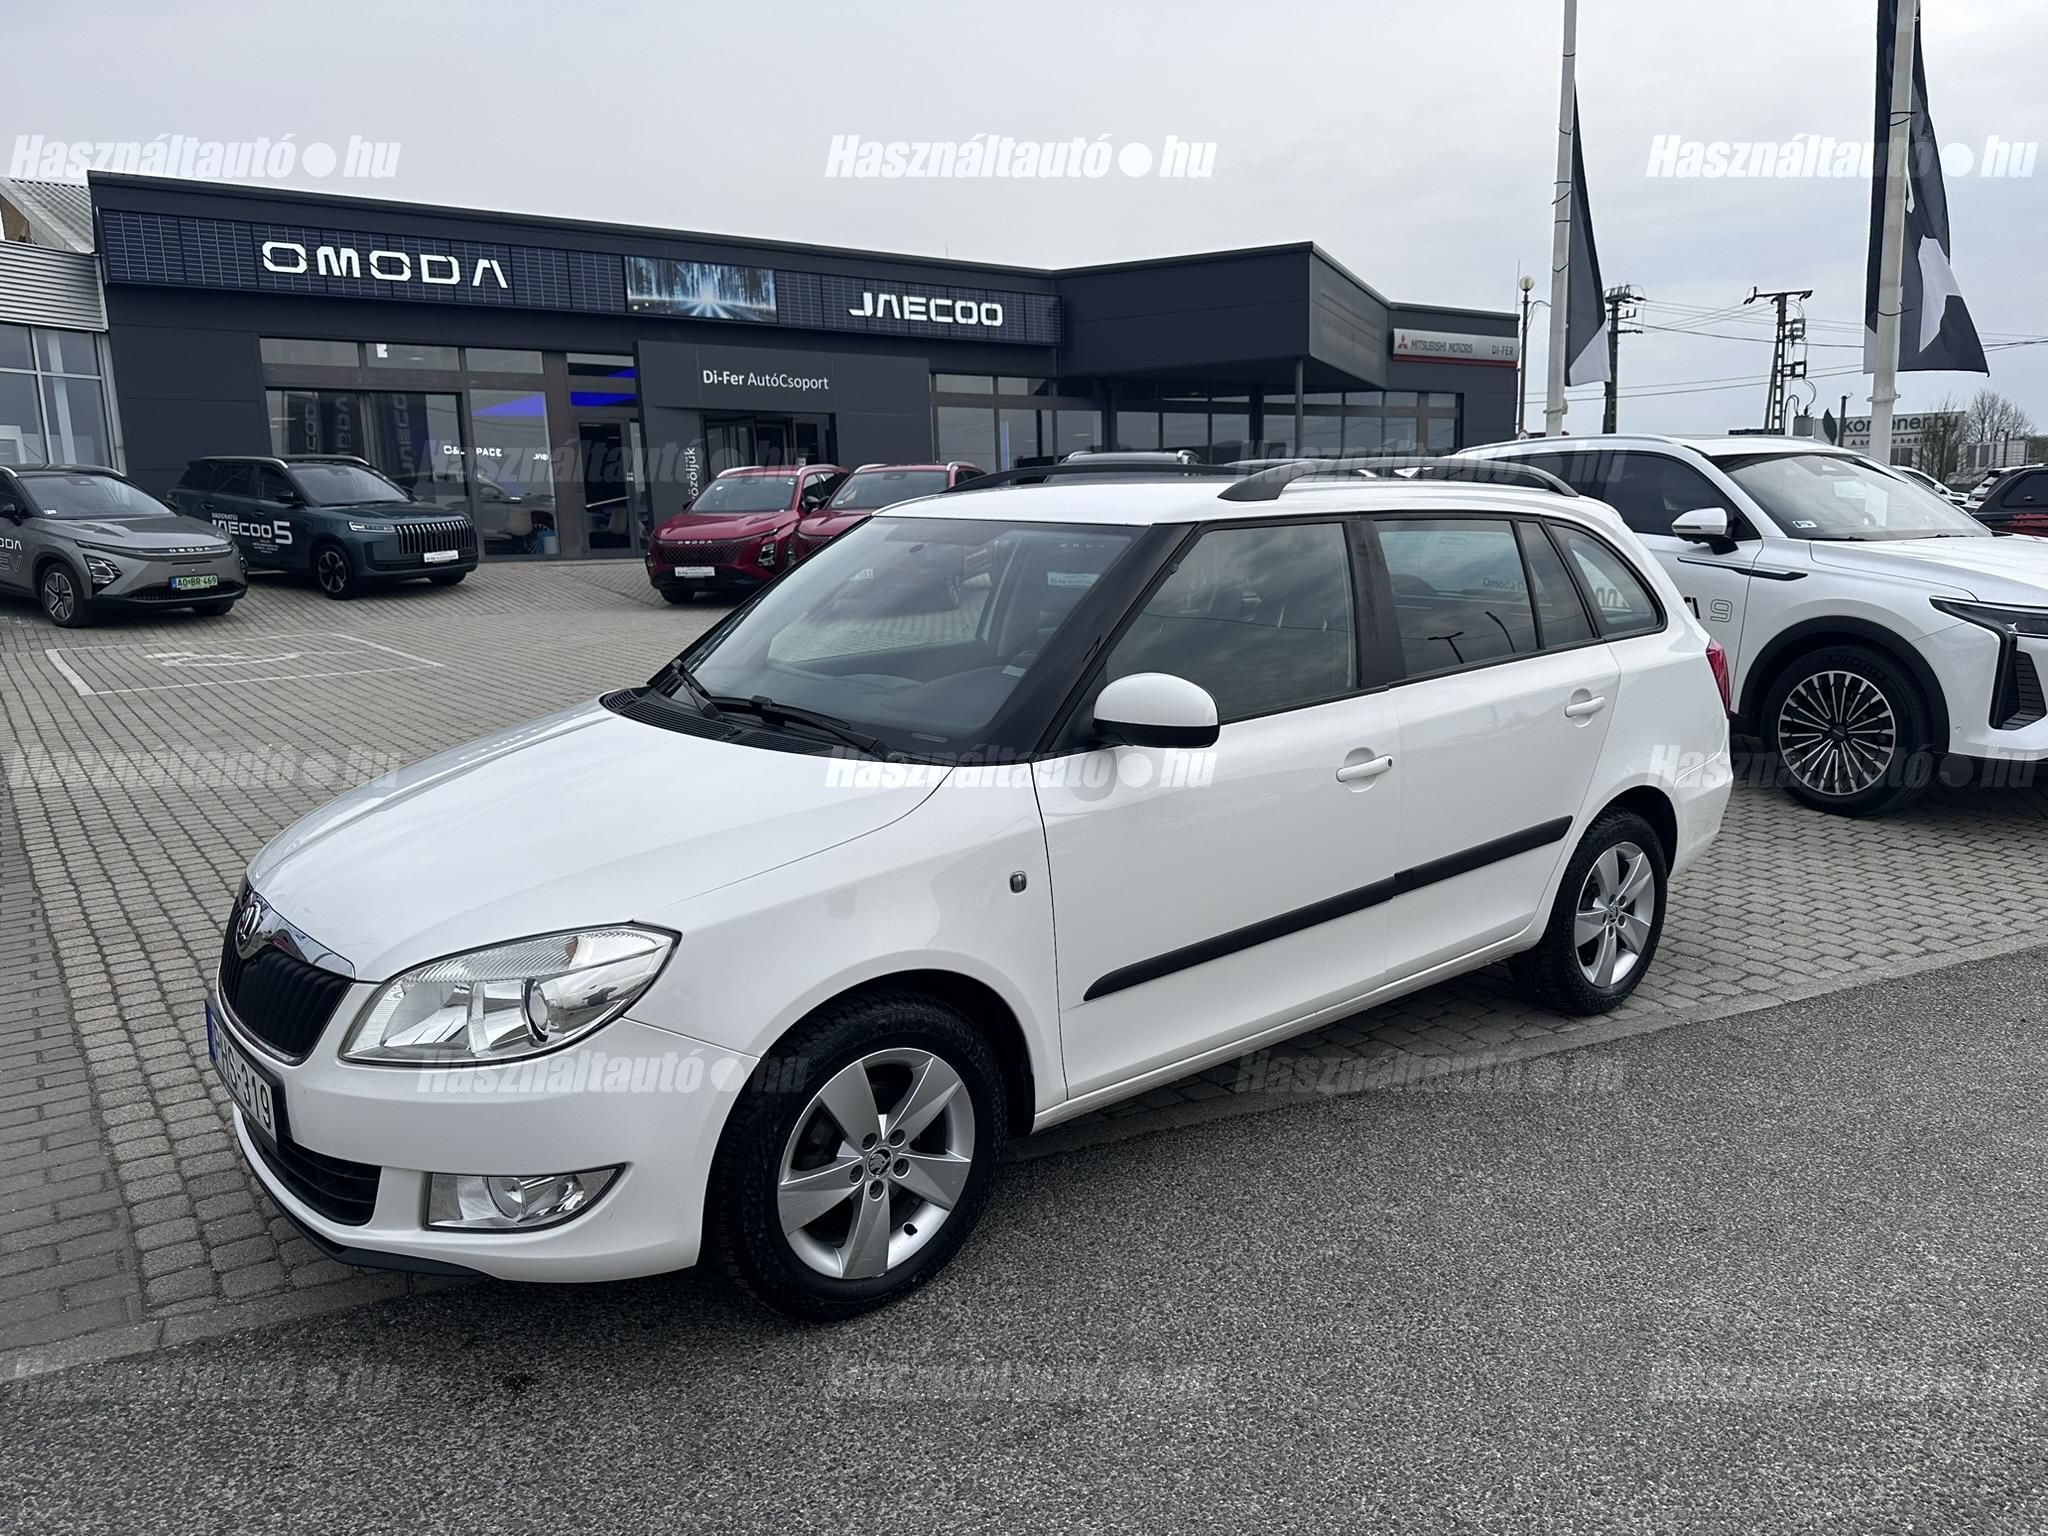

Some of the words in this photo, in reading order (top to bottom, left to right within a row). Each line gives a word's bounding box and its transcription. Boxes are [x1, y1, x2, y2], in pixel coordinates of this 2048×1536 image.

[262, 240, 508, 289] OMODA
[848, 292, 1003, 327] JAECOO
[1448, 341, 1473, 354] MOTORS
[703, 369, 744, 385] Di-Fer
[747, 372, 829, 391] AutóCsoport
[475, 447, 502, 457] PACE
[684, 447, 700, 500] özöljük
[273, 520, 293, 545] 5
